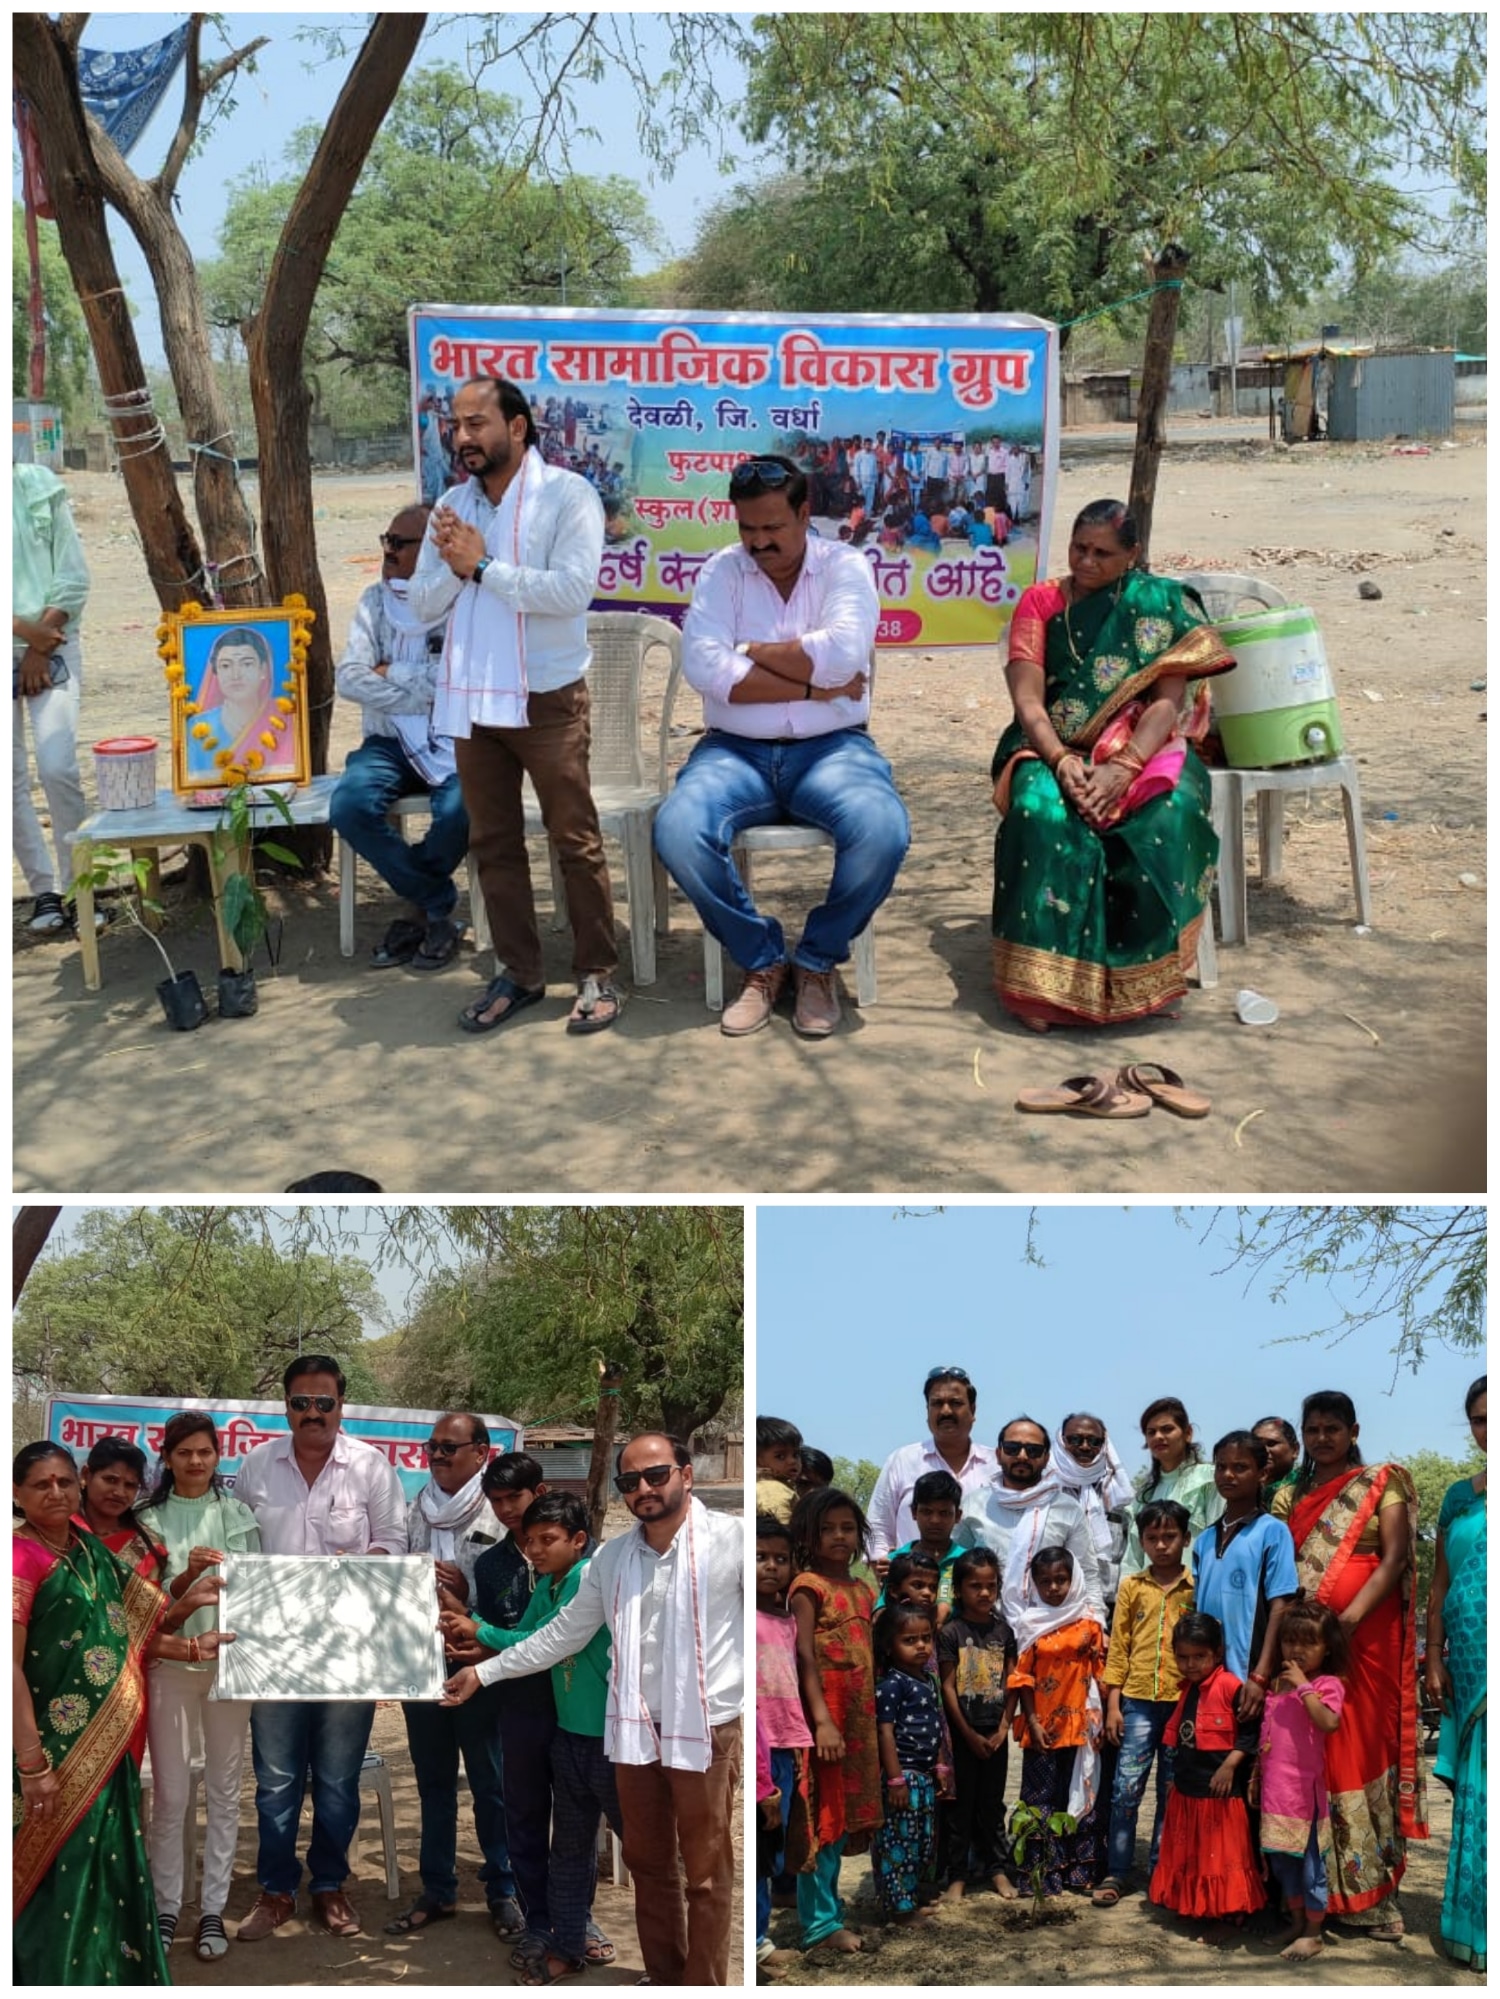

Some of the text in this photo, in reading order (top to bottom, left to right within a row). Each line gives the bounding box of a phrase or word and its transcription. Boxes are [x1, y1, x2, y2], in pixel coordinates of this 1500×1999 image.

[433, 331, 1029, 405] भारत सामाजिक विकास ग्रुप
[626, 397, 821, 432] देवळी, जि. वर्धा
[597, 540, 646, 591] हर्ष
[926, 550, 1016, 603] आहे.
